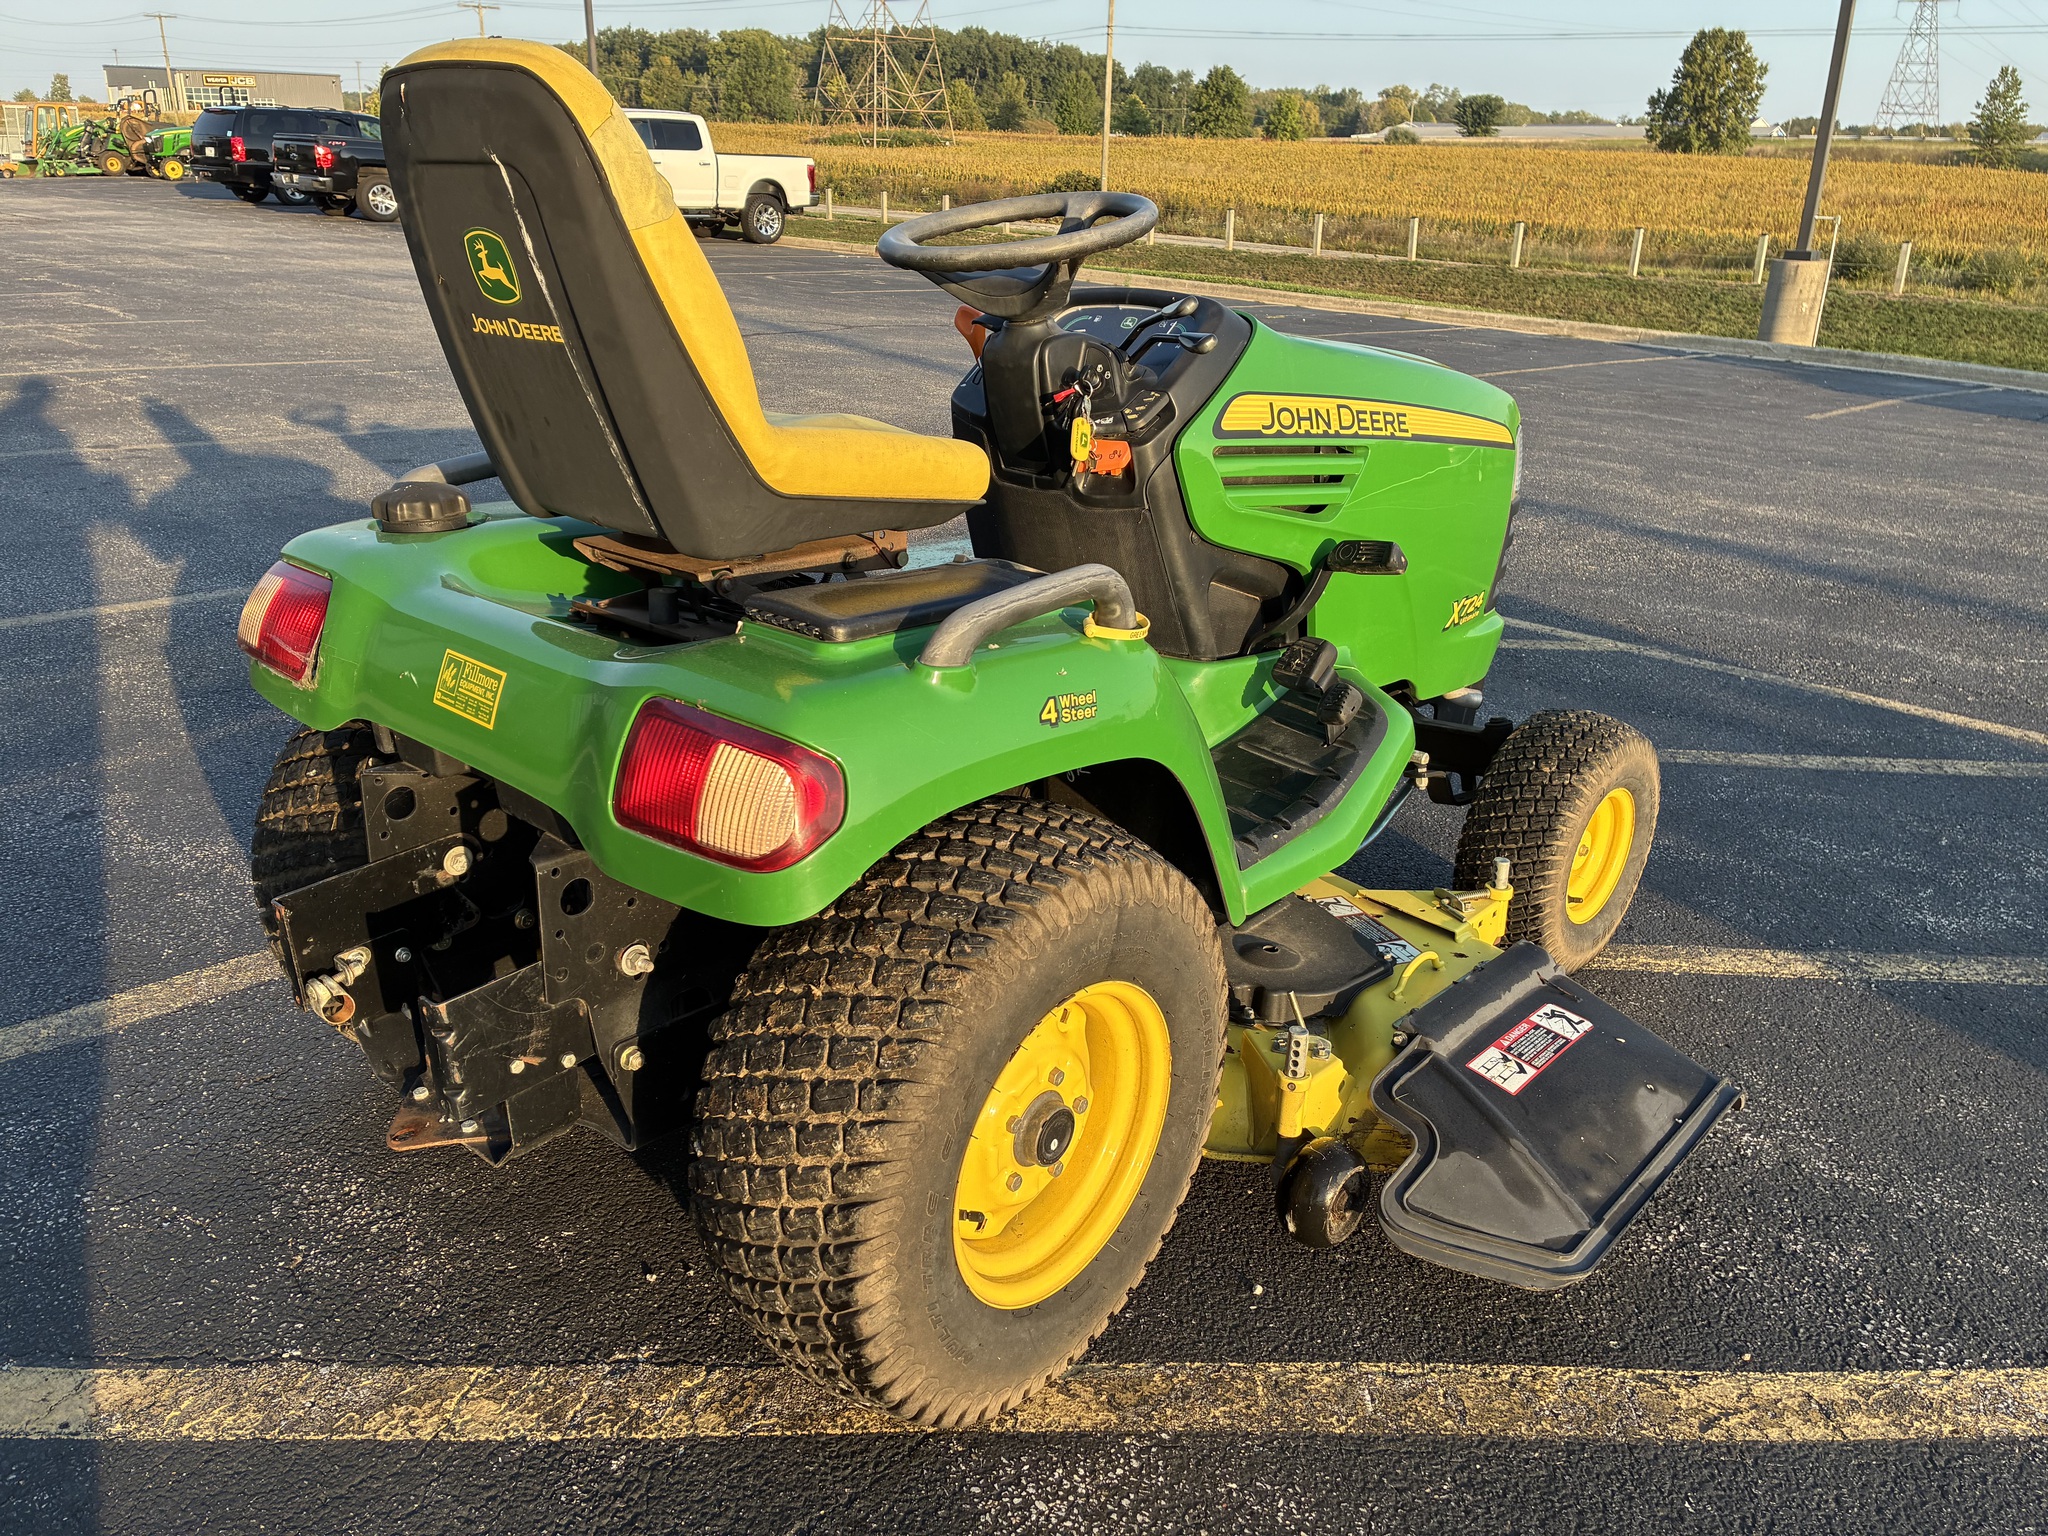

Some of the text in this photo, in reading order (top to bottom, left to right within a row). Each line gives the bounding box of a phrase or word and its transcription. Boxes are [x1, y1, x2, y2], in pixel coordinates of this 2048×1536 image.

[231, 76, 254, 85] JCB
[471, 313, 565, 343] JOHN DEERE
[1262, 402, 1409, 433] JOHN DEERE
[462, 661, 499, 691] Fillmore
[1040, 689, 1097, 726] 4 Wheel
[1061, 705, 1097, 723] Steer
[1504, 1022, 1531, 1042] DANGER
[1187, 986, 1214, 1149] CARLISLE
[920, 1190, 939, 1294] TRAC
[925, 1301, 974, 1367] MULTI
